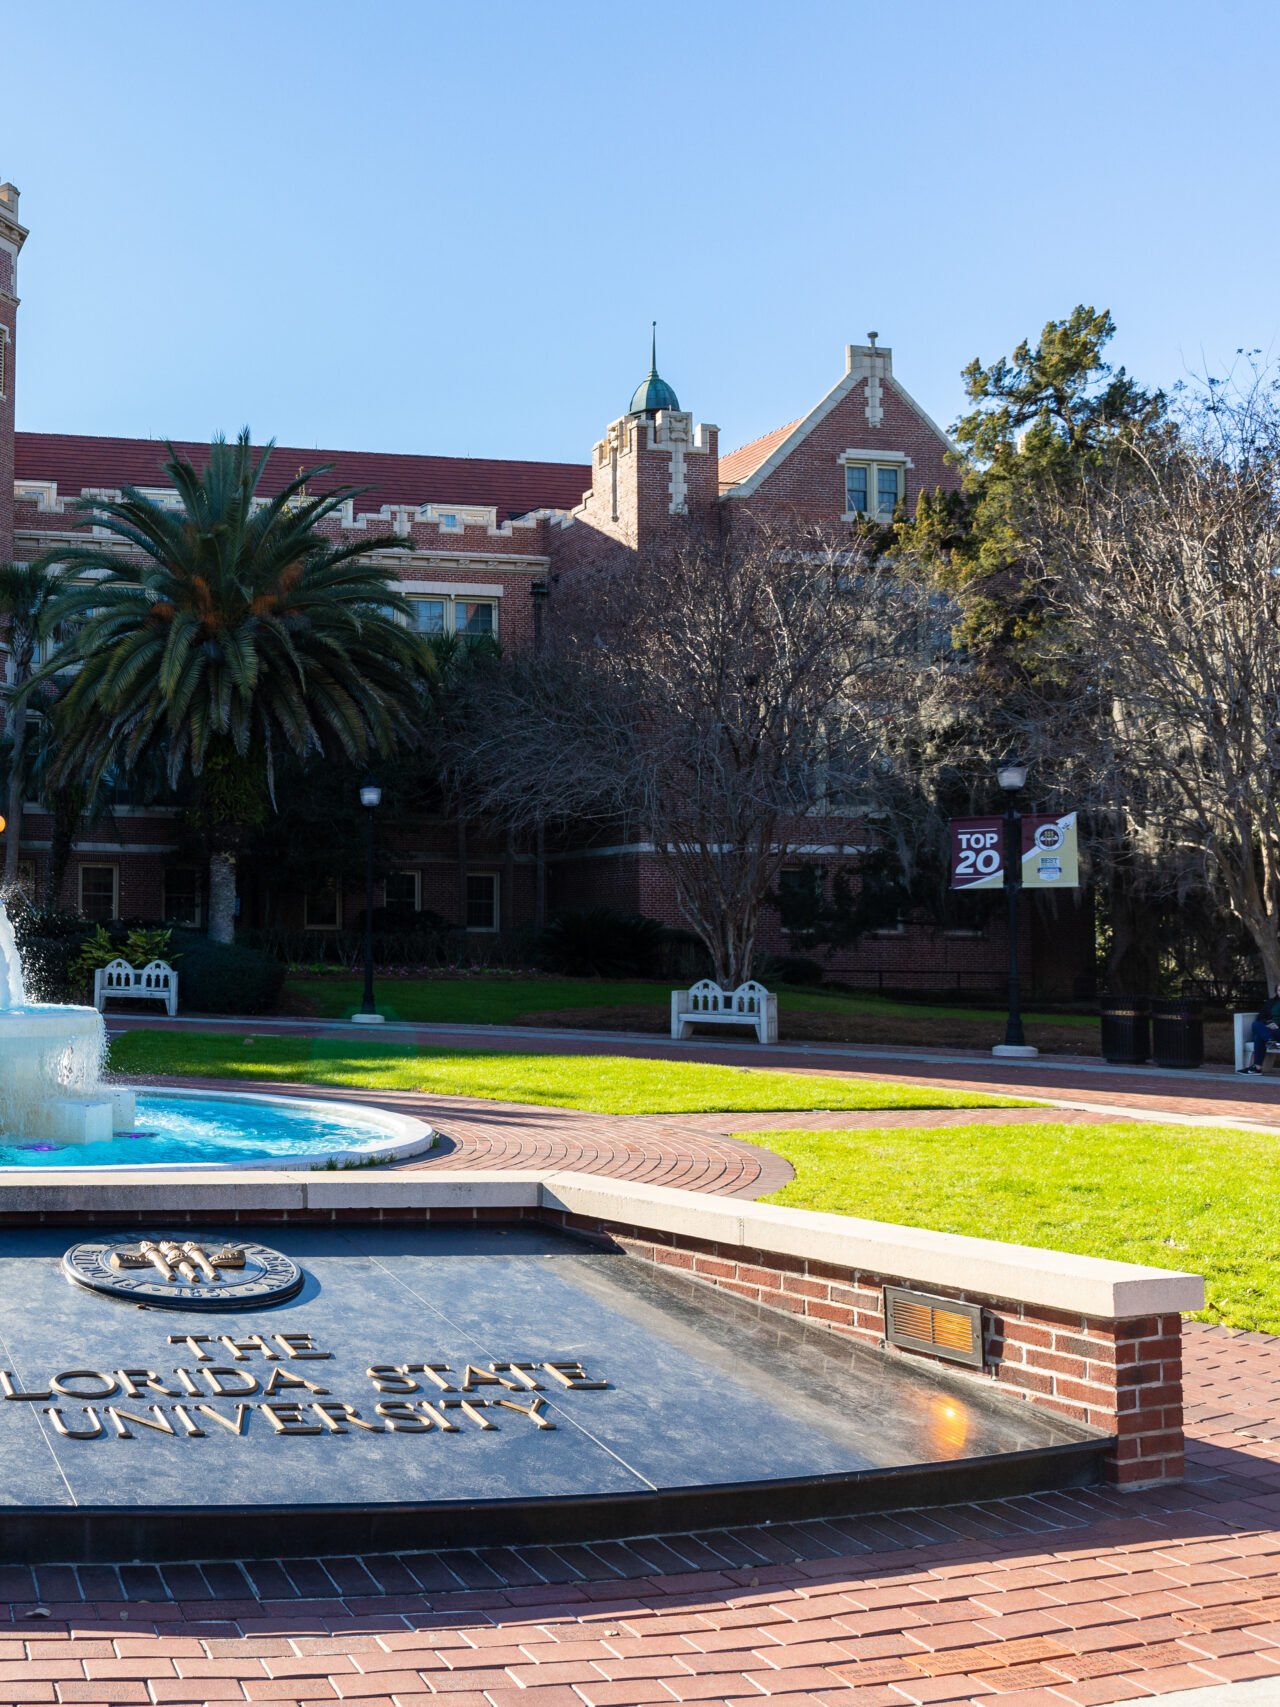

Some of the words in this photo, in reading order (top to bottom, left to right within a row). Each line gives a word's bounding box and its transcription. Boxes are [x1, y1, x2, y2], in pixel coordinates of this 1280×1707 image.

[958, 833, 998, 849] TOP
[955, 850, 1000, 874] 20
[174, 1287, 237, 1299] 1851
[167, 1333, 335, 1361] THE
[365, 1362, 608, 1395] STATE
[42, 1398, 558, 1440] UNIVERSITY
